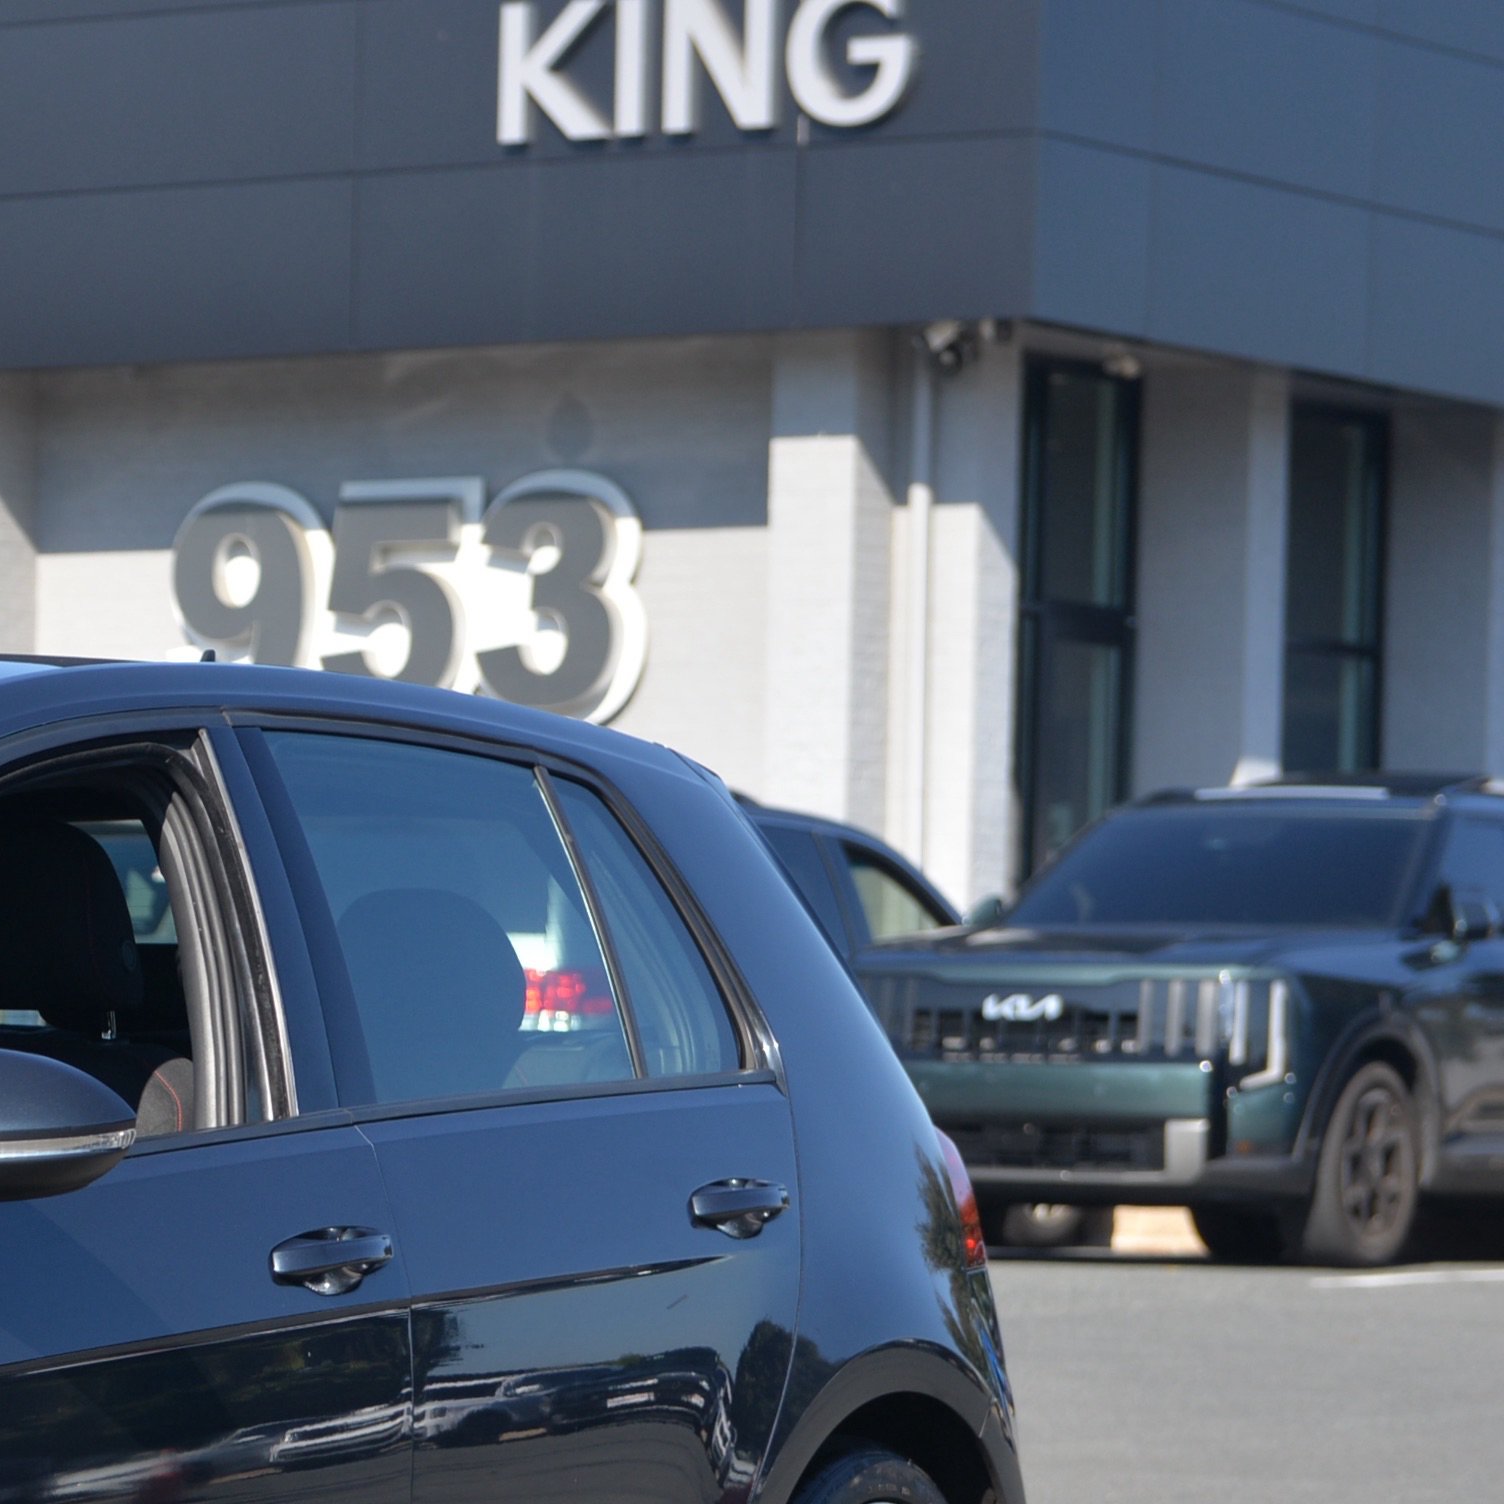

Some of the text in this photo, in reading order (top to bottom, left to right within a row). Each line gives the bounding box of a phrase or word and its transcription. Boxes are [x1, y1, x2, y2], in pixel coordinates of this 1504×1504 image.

[496, 0, 916, 145] KING
[172, 468, 648, 726] 953
[982, 993, 1063, 1021] KIA
